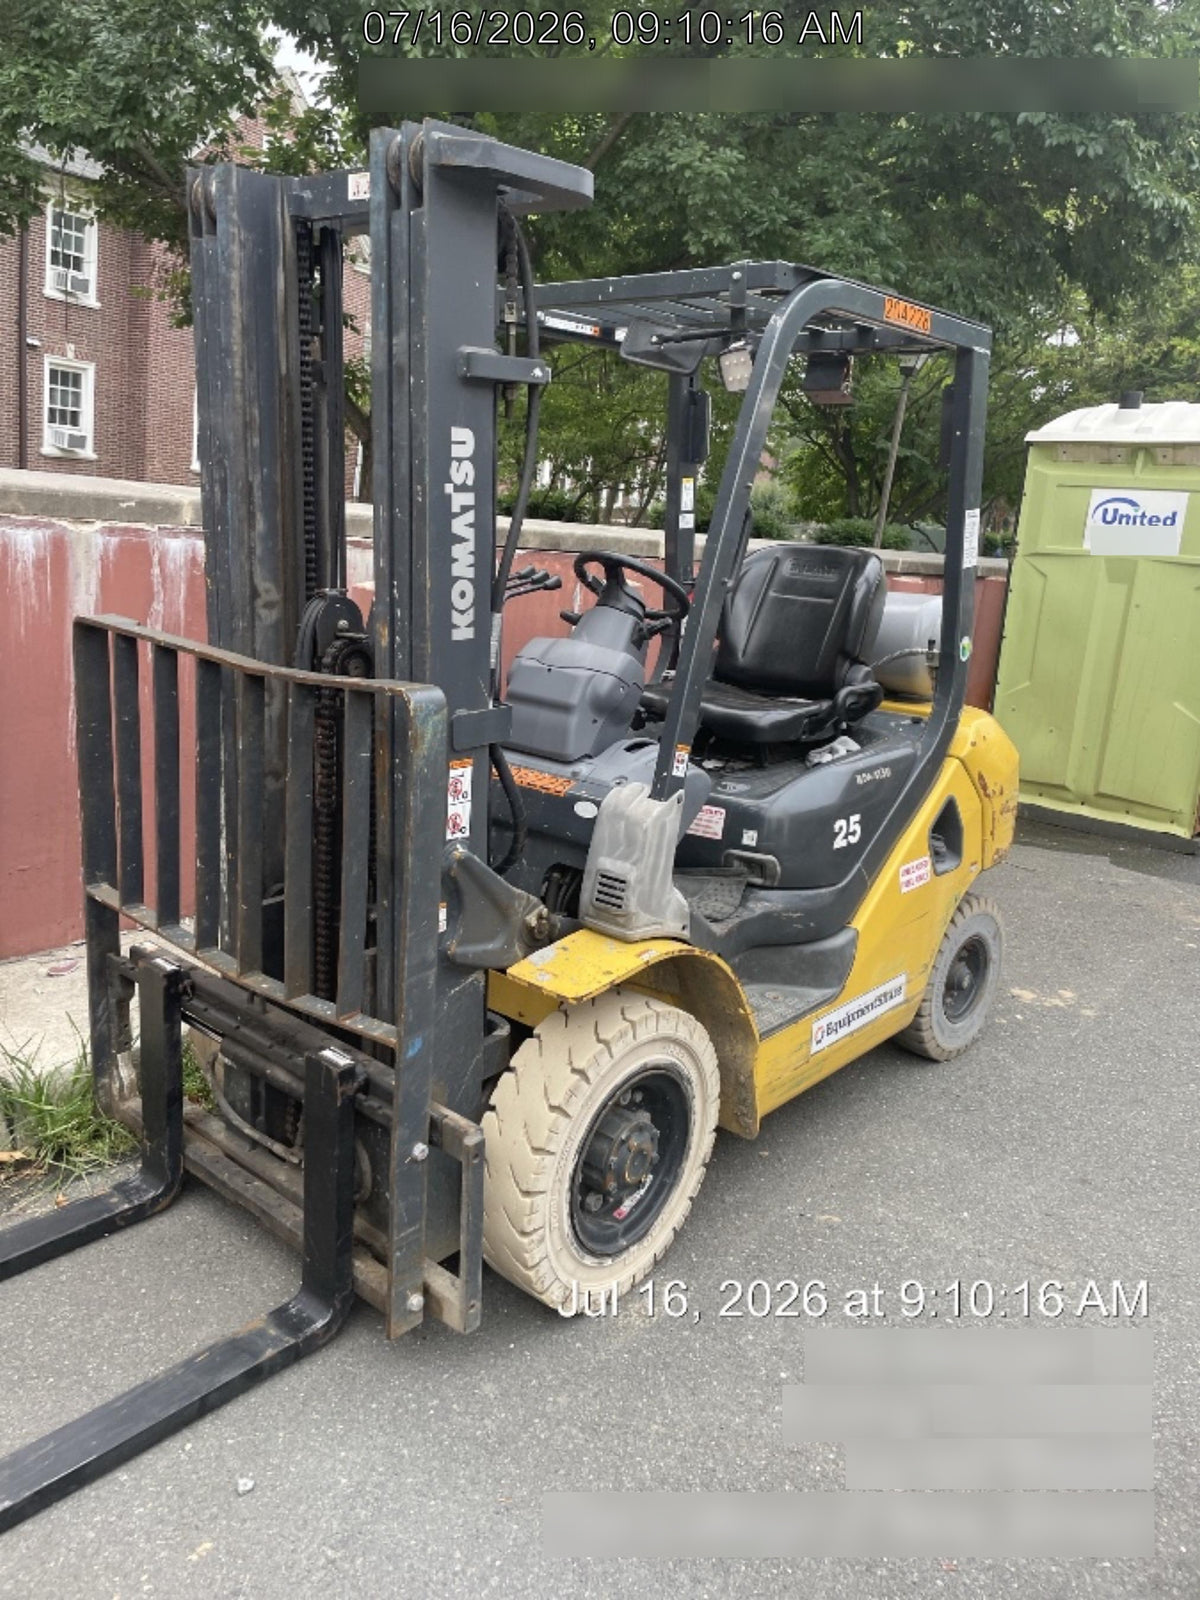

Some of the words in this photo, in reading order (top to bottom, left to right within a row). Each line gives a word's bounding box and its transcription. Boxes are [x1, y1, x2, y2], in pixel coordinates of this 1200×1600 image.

[444, 426, 475, 641] KOMATSU
[1101, 507, 1178, 527] United
[833, 813, 861, 850] 25
